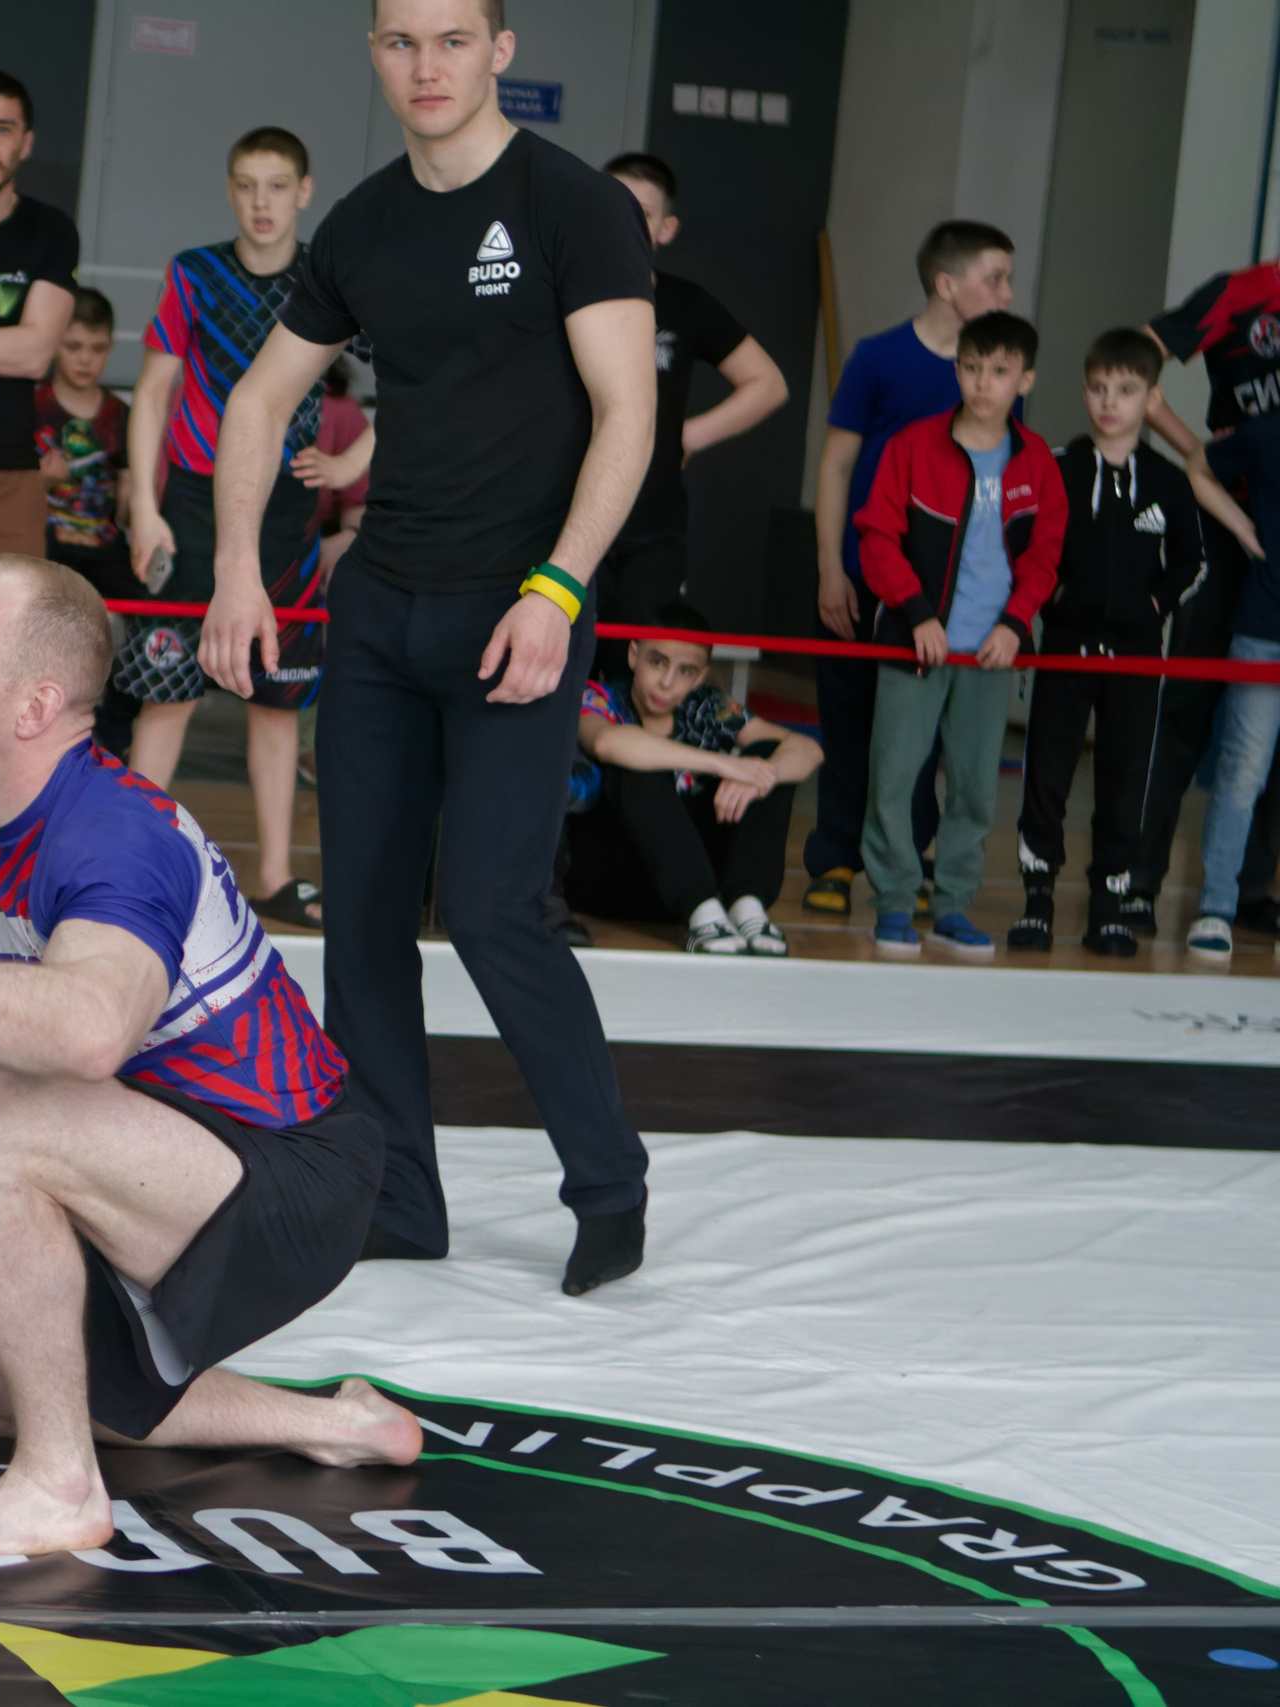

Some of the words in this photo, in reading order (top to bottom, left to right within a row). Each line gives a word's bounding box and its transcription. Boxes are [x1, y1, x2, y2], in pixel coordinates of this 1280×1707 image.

[468, 261, 521, 284] BUDO
[475, 282, 511, 297] FIGHT
[1233, 371, 1280, 416] СИ
[416, 1414, 1147, 1591] GRAPPLIN
